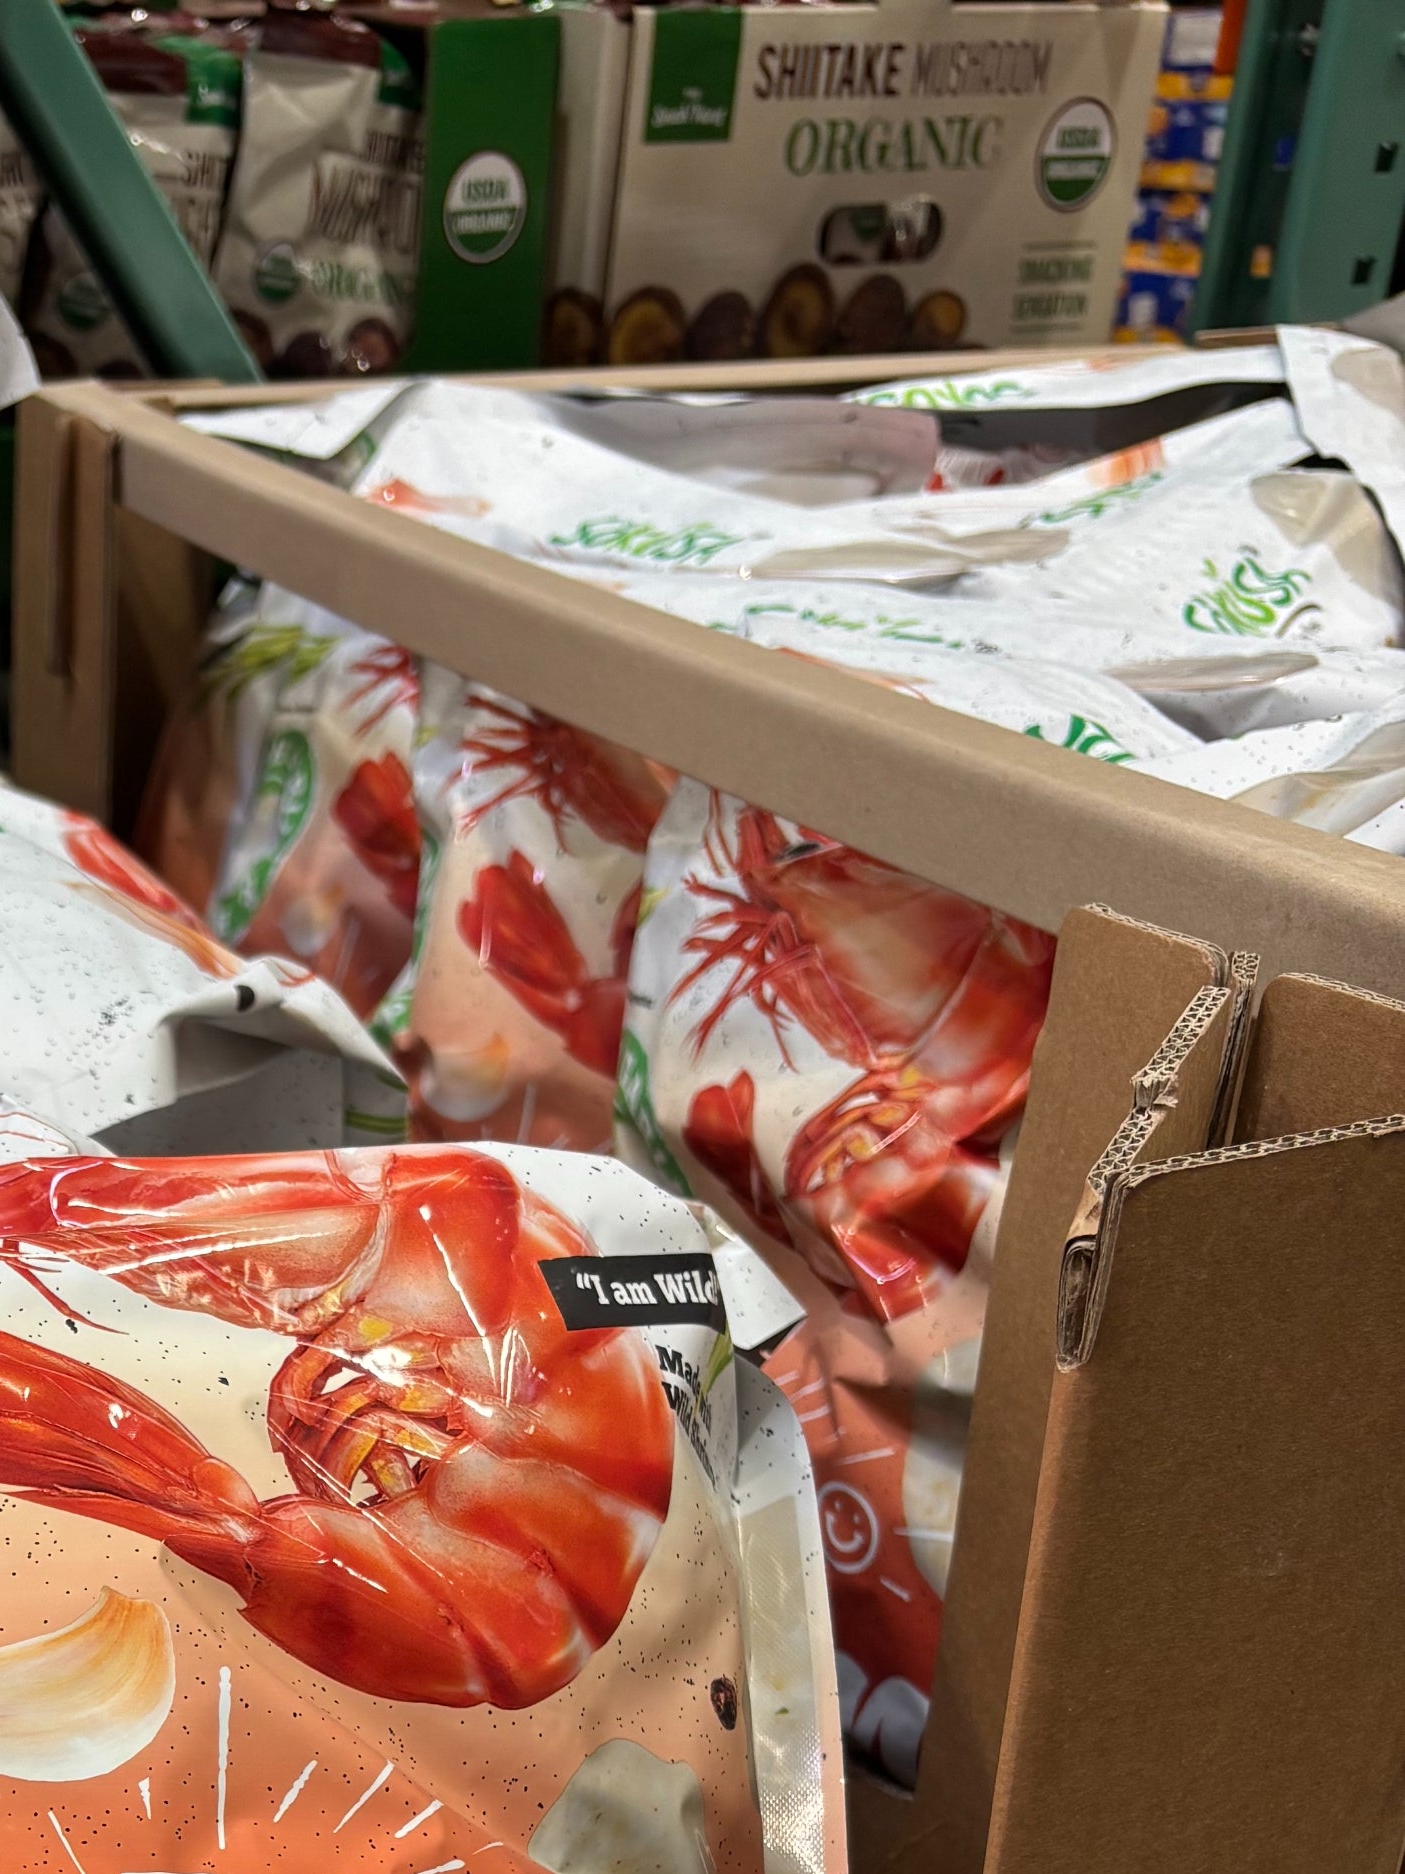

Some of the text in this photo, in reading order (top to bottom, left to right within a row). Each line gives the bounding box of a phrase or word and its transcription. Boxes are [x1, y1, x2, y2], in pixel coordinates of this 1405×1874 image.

[753, 40, 1054, 99] SHIITAKE MUSHROOM
[784, 114, 1004, 176] ORGANIC
[610, 1281, 658, 1306] am
